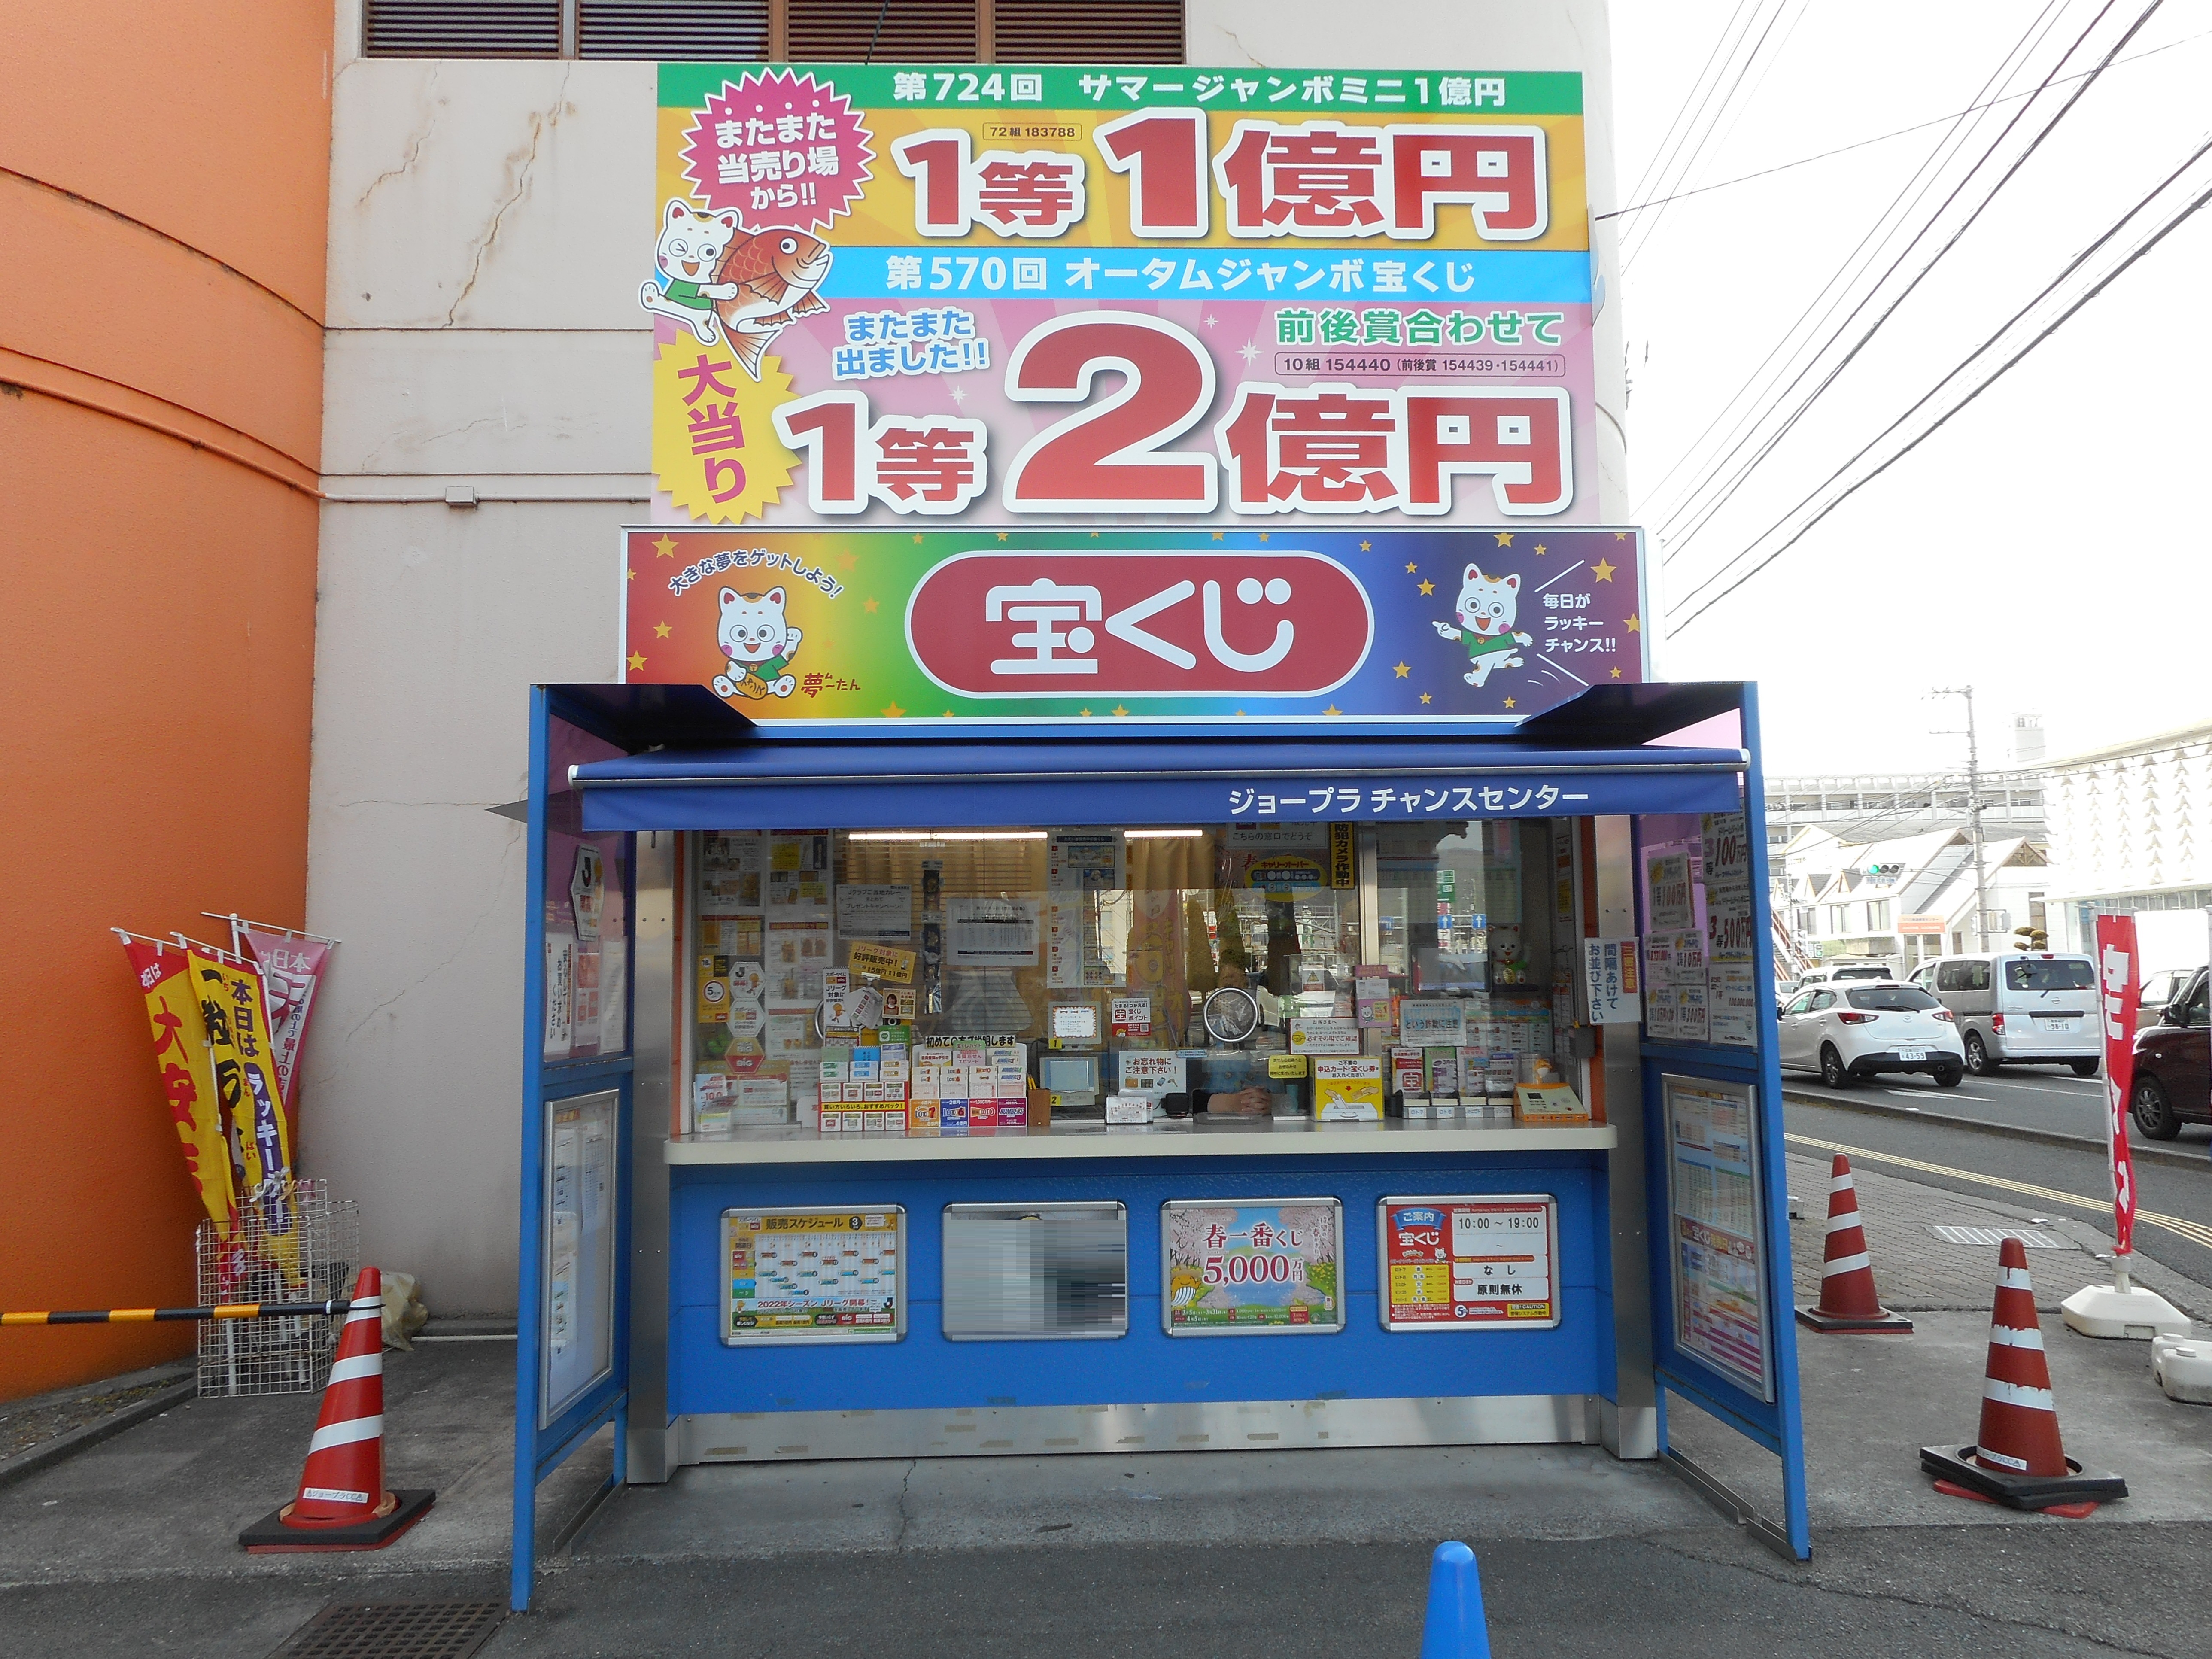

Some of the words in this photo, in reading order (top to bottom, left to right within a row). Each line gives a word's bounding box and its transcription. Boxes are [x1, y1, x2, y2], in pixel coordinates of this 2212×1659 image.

[893, 73, 1043, 101] 第724回
[1079, 74, 1506, 106] サマージャンボミニ1億円
[714, 114, 836, 147] またまた
[989, 125, 1021, 138] 72組
[1024, 126, 1075, 138] 183788
[717, 147, 839, 184] 当売り場
[899, 135, 1077, 230] 1等
[1101, 114, 1541, 234] 1億円
[886, 256, 1047, 290] 第570回
[1066, 258, 1364, 292] オータムジャンボ
[1373, 260, 1475, 292] 宝くじ
[848, 310, 972, 341] またまた
[1276, 309, 1563, 345] 前後賞合わせて
[836, 343, 988, 377] 出ました!!
[1283, 358, 1320, 371] 10組
[1325, 358, 1390, 371] 154440
[678, 354, 746, 503] 大当り
[781, 397, 979, 507] 1等
[668, 549, 844, 599] 大きな夢をゲットしよう!
[1543, 593, 1590, 609] 毎日が
[986, 578, 1294, 674] 宝くじ
[1544, 616, 1604, 630] ラッキー
[1545, 638, 1616, 653] チャンス!!
[1229, 786, 1361, 815] ジョープラ
[1370, 784, 1589, 814] チャンスセンター
[1233, 832, 1312, 841] こちらの窓口でどうぞ
[1335, 823, 1349, 886] 防犯カメラ作動中
[140, 962, 162, 988] 本日は
[1589, 944, 1604, 1022] お並び下さい
[1604, 944, 1618, 1009] 間隔あけて
[231, 978, 259, 1057] 本日は
[766, 1217, 843, 1230] 販売スケジュール
[1403, 1211, 1434, 1221] ご案内
[1459, 1217, 1489, 1229] 10:00
[1508, 1217, 1539, 1228] 19:00
[1204, 1223, 1303, 1248] 春一番くじ
[1398, 1231, 1440, 1246] 宝くじ
[1203, 1255, 1304, 1286] 5,000万円
[757, 1300, 817, 1308] 2022年シーズン
[1477, 1284, 1522, 1295] 原則無休
